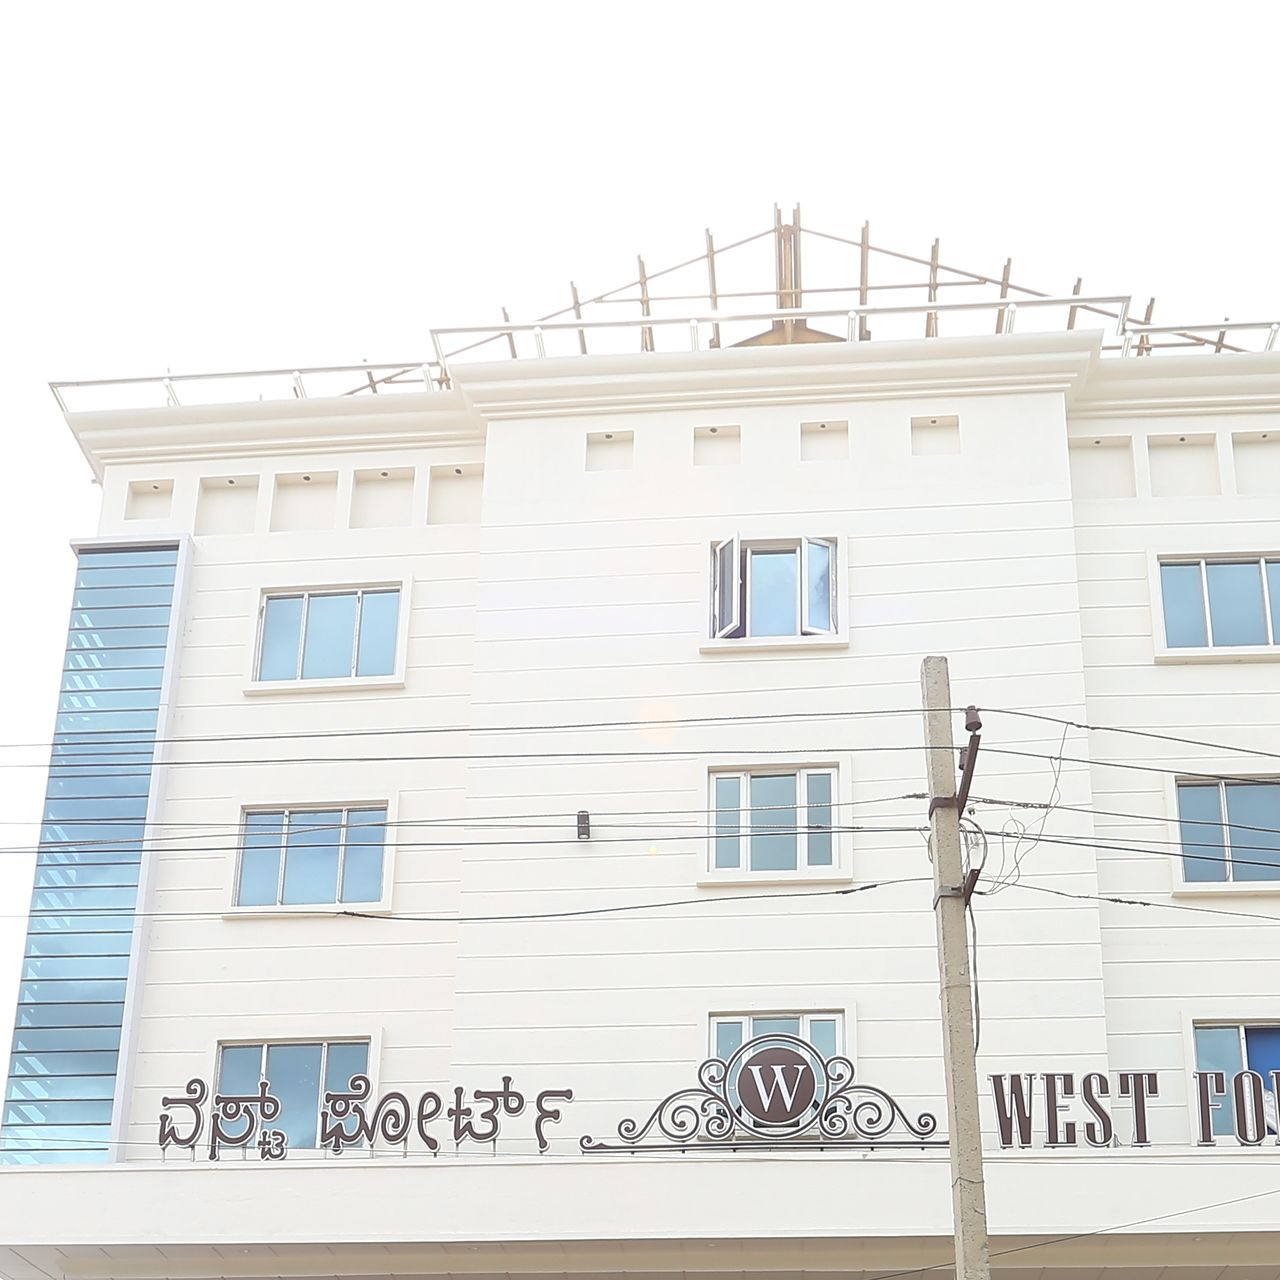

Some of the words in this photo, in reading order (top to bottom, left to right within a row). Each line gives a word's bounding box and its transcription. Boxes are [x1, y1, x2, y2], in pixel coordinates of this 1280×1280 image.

[158, 1077, 288, 1161] ವೆಸ್ಟ್
[320, 1074, 574, 1155] ಫೋರ್ಟ್
[747, 1064, 807, 1113] W
[988, 1072, 1159, 1148] WEST
